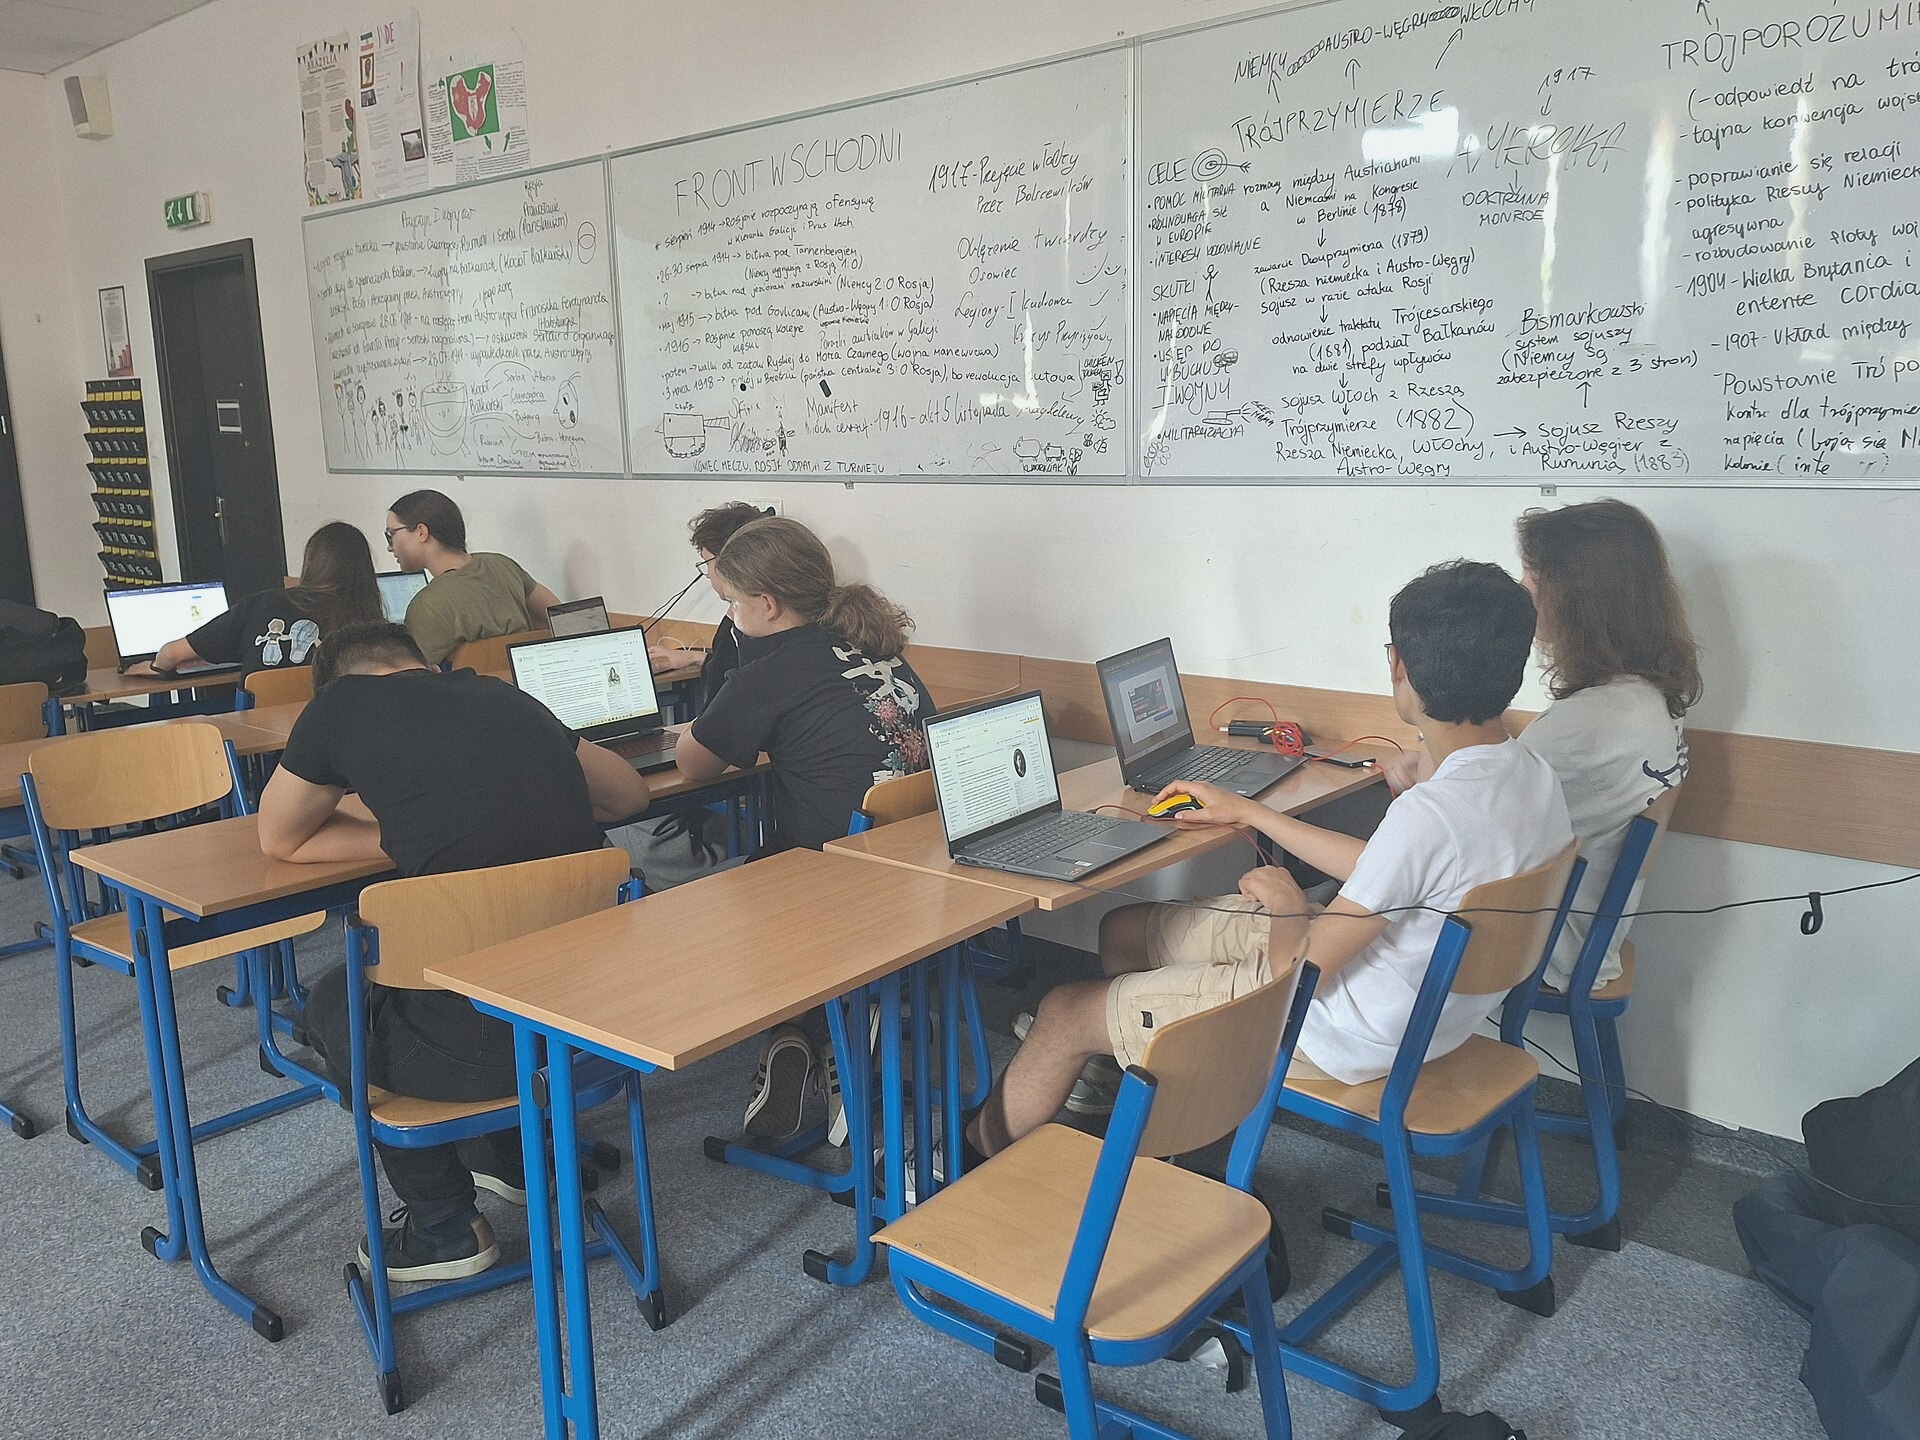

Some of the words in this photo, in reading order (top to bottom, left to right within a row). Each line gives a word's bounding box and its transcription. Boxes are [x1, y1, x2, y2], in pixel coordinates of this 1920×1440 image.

[1661, 2, 1920, 73] TRÓJPOROZUMI
[1538, 66, 1597, 95] 1917
[1832, 73, 1866, 91] na
[1231, 89, 1445, 152] TRÓJPRZYMIERZE
[674, 158, 764, 216] FRONT
